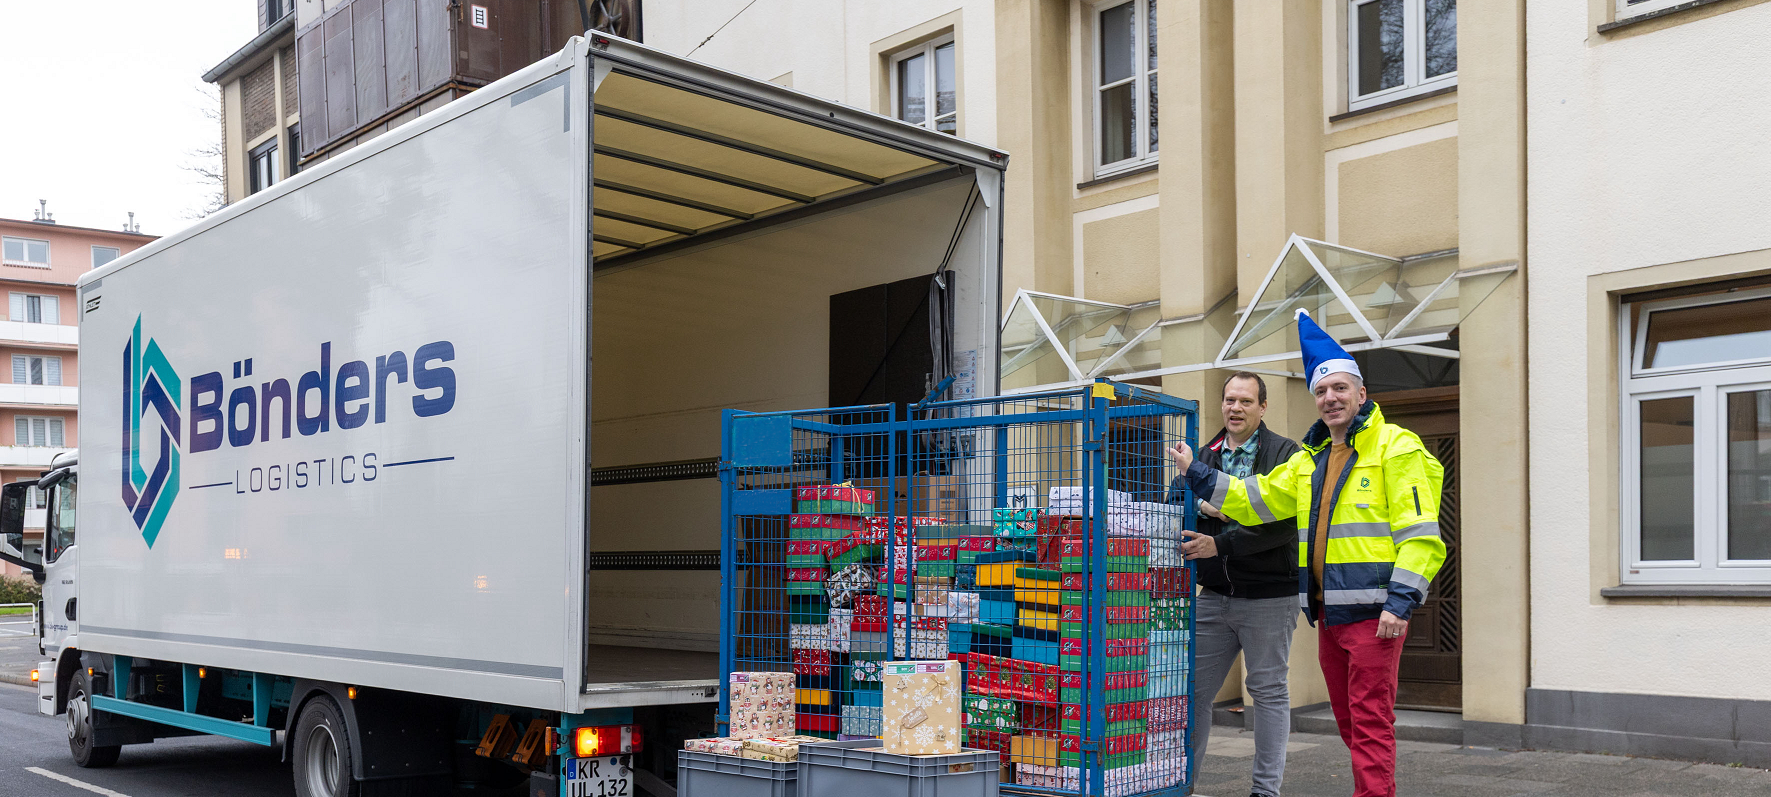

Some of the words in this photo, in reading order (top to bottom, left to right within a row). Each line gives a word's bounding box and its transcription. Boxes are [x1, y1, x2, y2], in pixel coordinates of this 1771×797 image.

[189, 340, 457, 454] Bönders
[235, 452, 378, 494] LOGISTICS
[578, 760, 600, 779] KR
[571, 781, 593, 797] UL
[597, 778, 628, 797] 132
